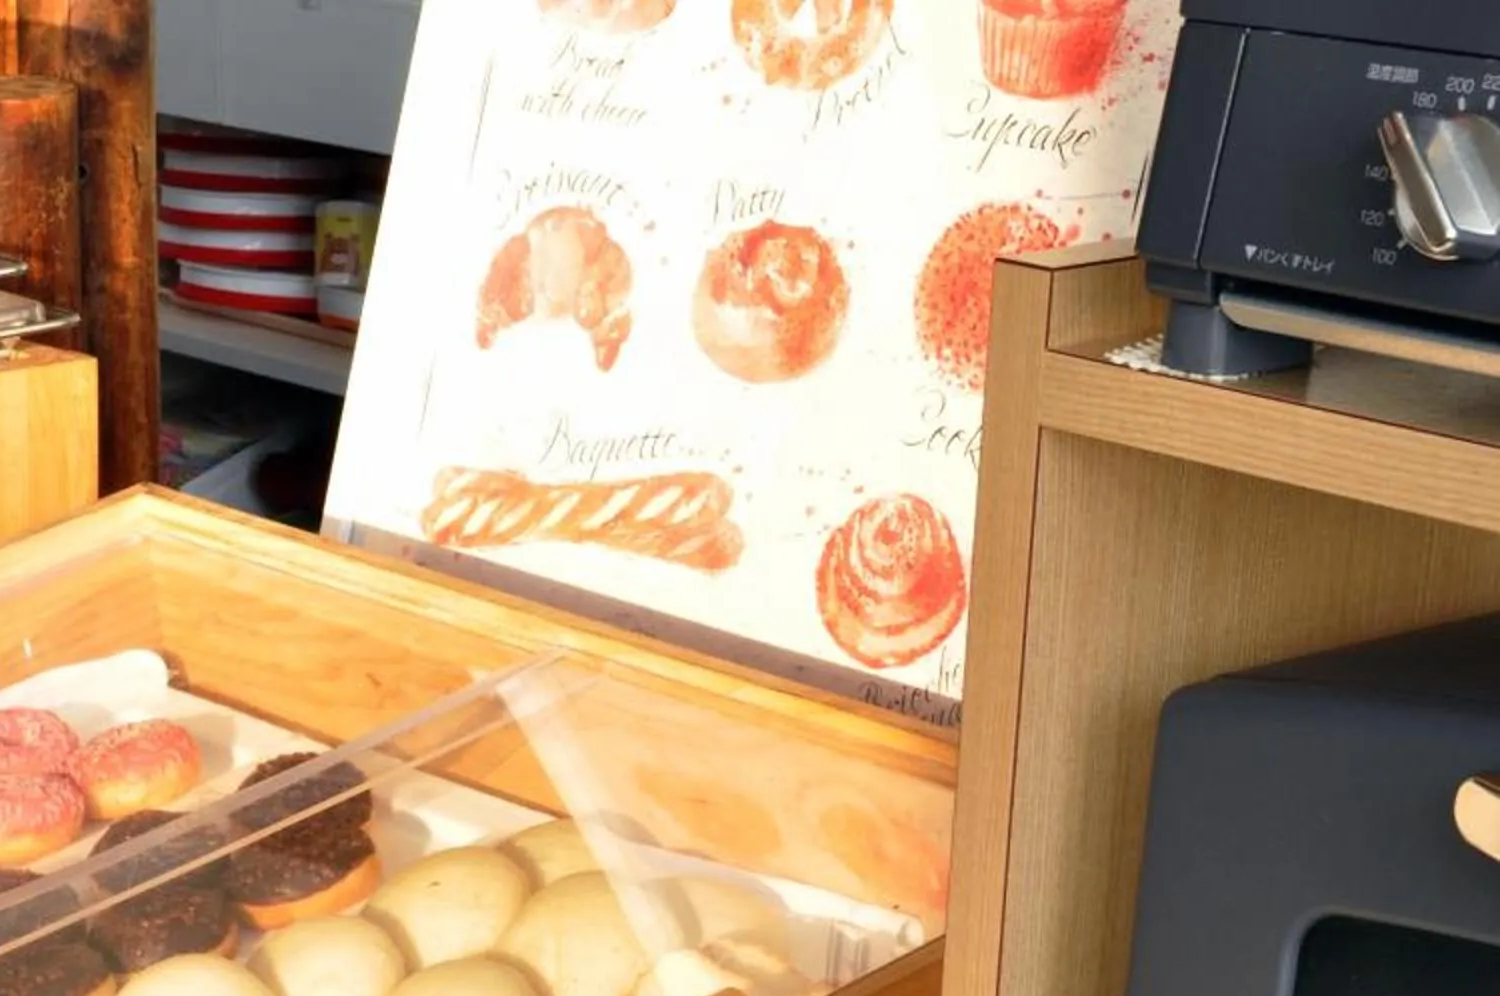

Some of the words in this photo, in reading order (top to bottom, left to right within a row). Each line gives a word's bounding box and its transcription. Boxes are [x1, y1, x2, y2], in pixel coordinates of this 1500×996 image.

[1444, 75, 1475, 94] 200
[1481, 72, 1500, 91] 22
[1412, 91, 1437, 108] 180
[946, 80, 1098, 172] Cupcake
[1360, 209, 1385, 227] 120
[1372, 247, 1397, 265] 100
